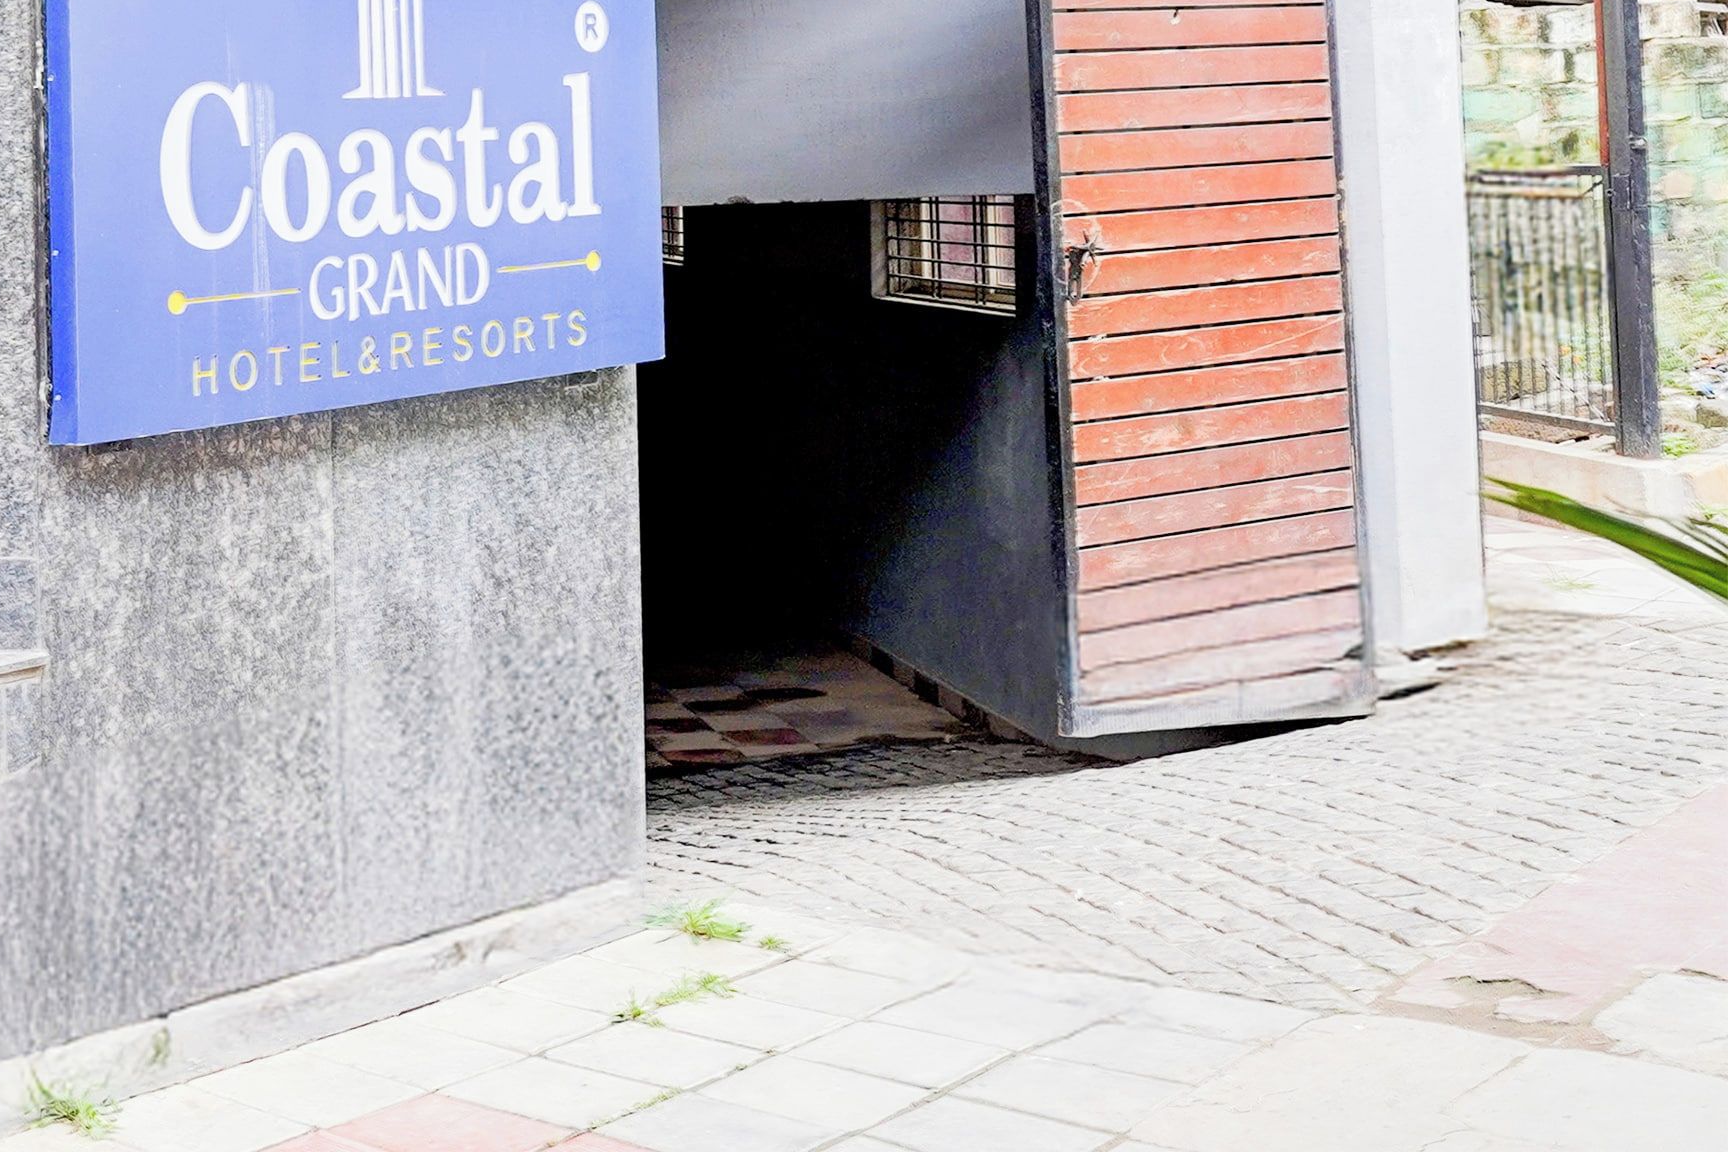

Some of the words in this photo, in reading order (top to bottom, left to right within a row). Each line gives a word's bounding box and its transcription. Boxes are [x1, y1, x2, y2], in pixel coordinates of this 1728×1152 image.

[160, 73, 602, 250] Coastal
[308, 243, 490, 321] GRAND
[191, 310, 589, 397] HOTEL&RESORTS
